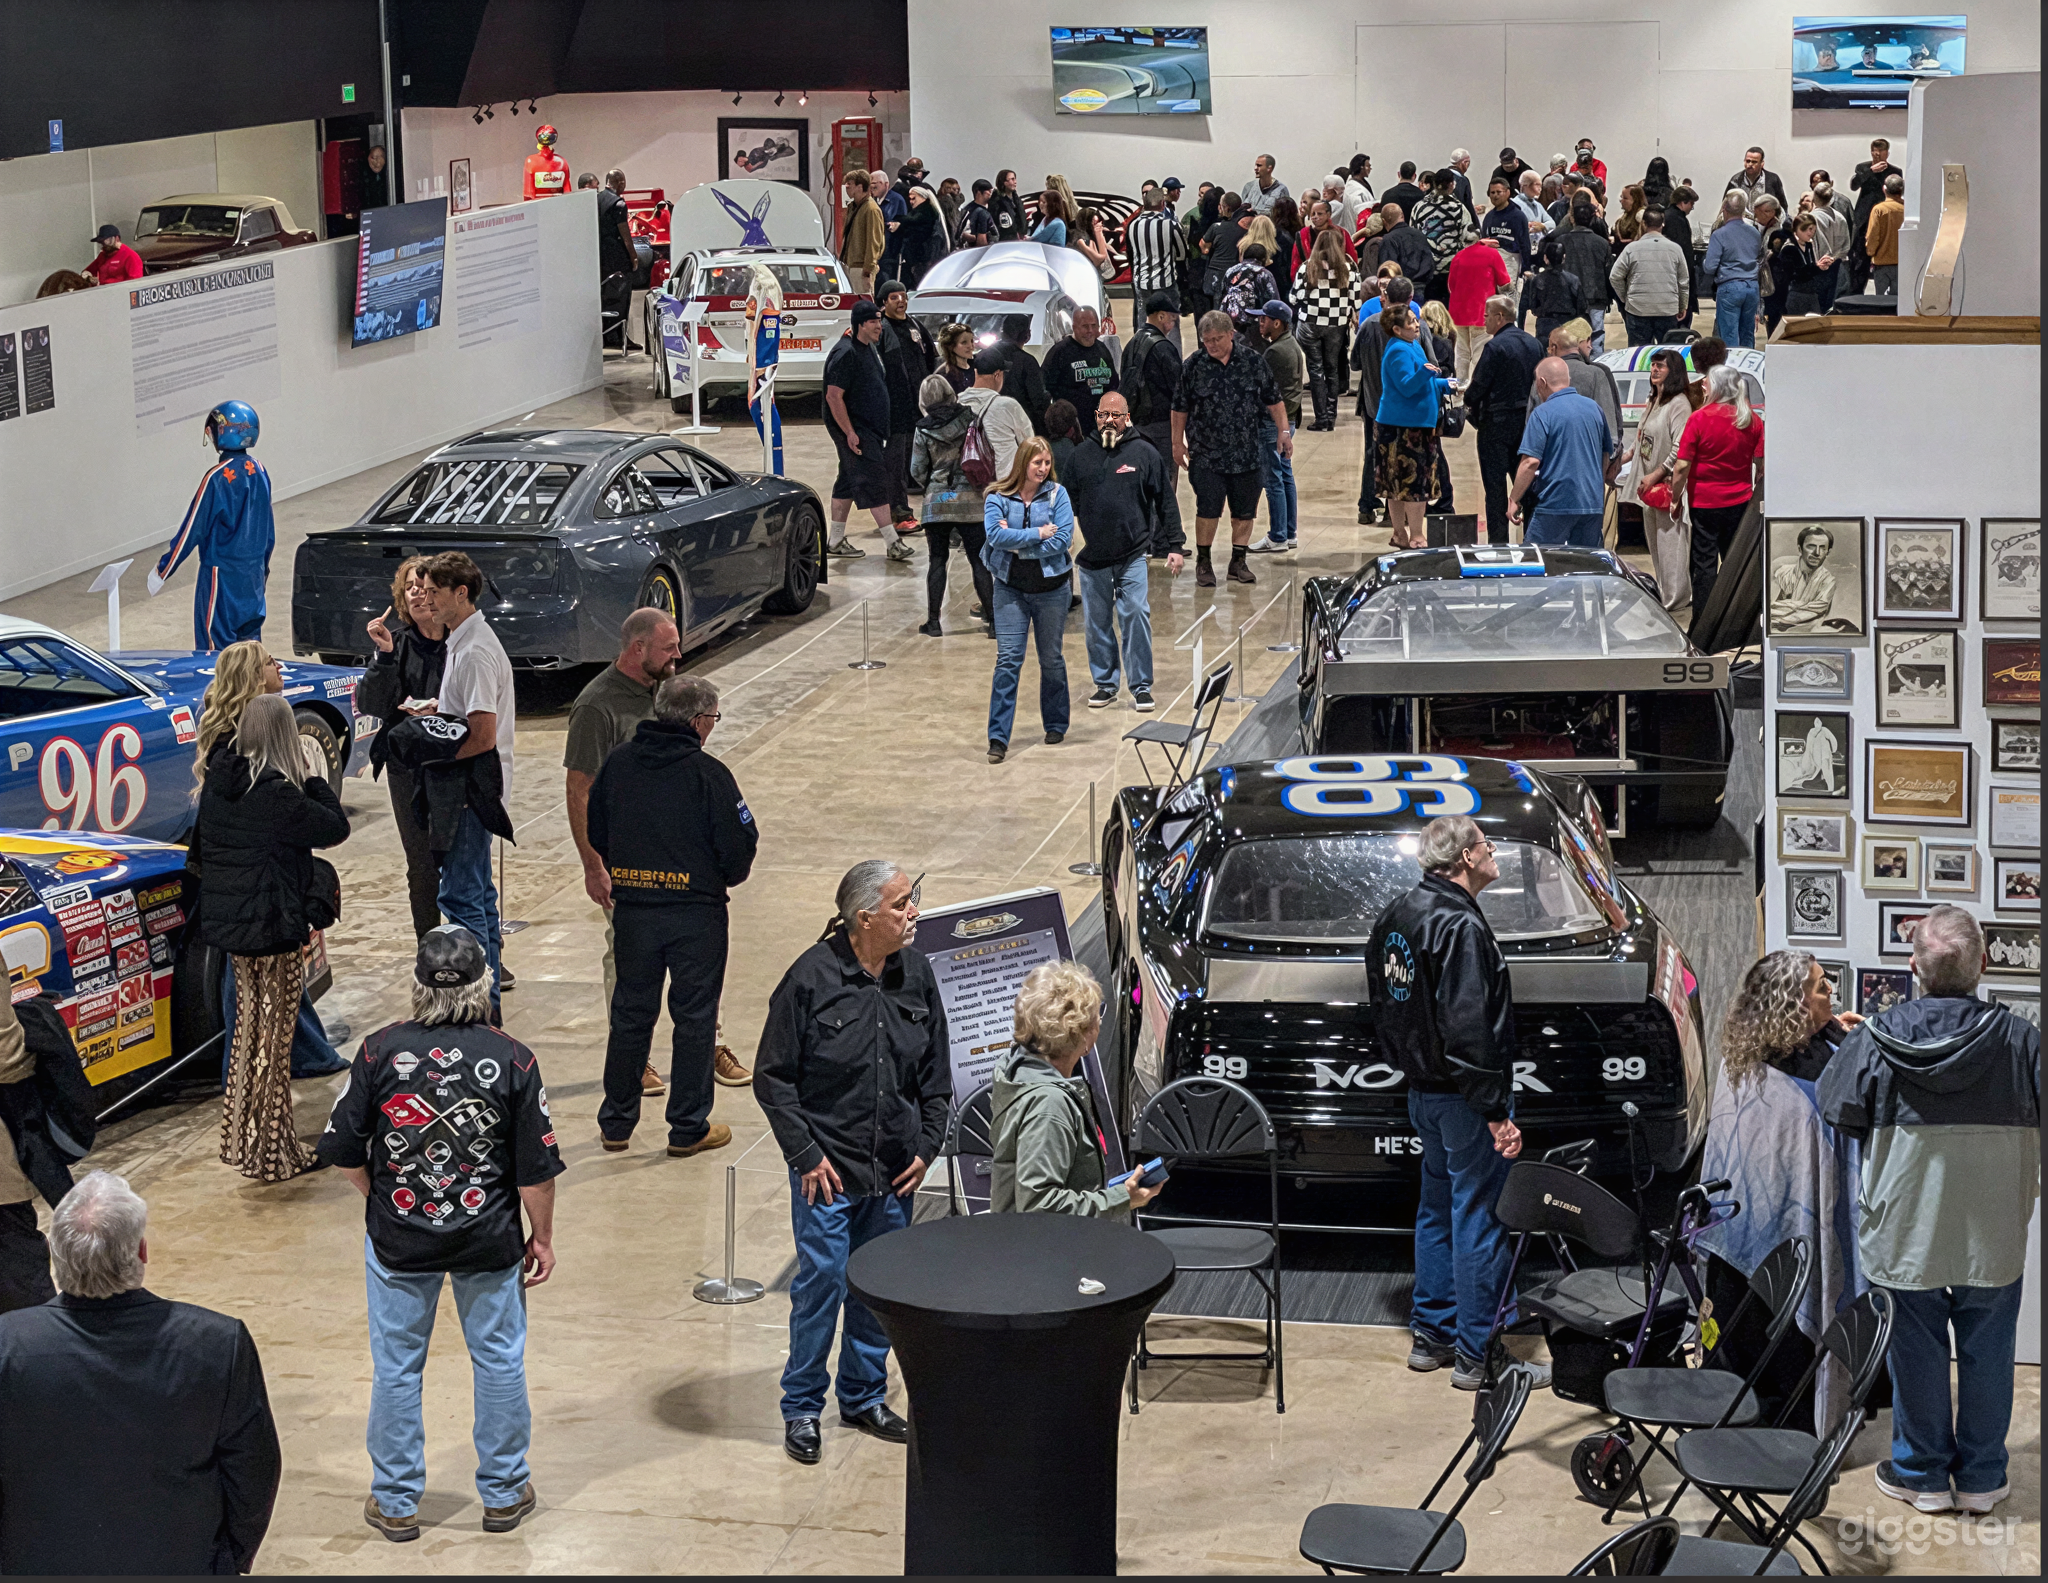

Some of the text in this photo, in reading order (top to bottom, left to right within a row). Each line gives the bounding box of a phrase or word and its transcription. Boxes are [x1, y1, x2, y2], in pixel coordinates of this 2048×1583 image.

[1663, 662, 1714, 684] 99
[38, 722, 148, 834] 96
[1203, 1054, 1248, 1080] 99
[1602, 1056, 1647, 1082] 99
[1374, 1136, 1424, 1155] HE'S
